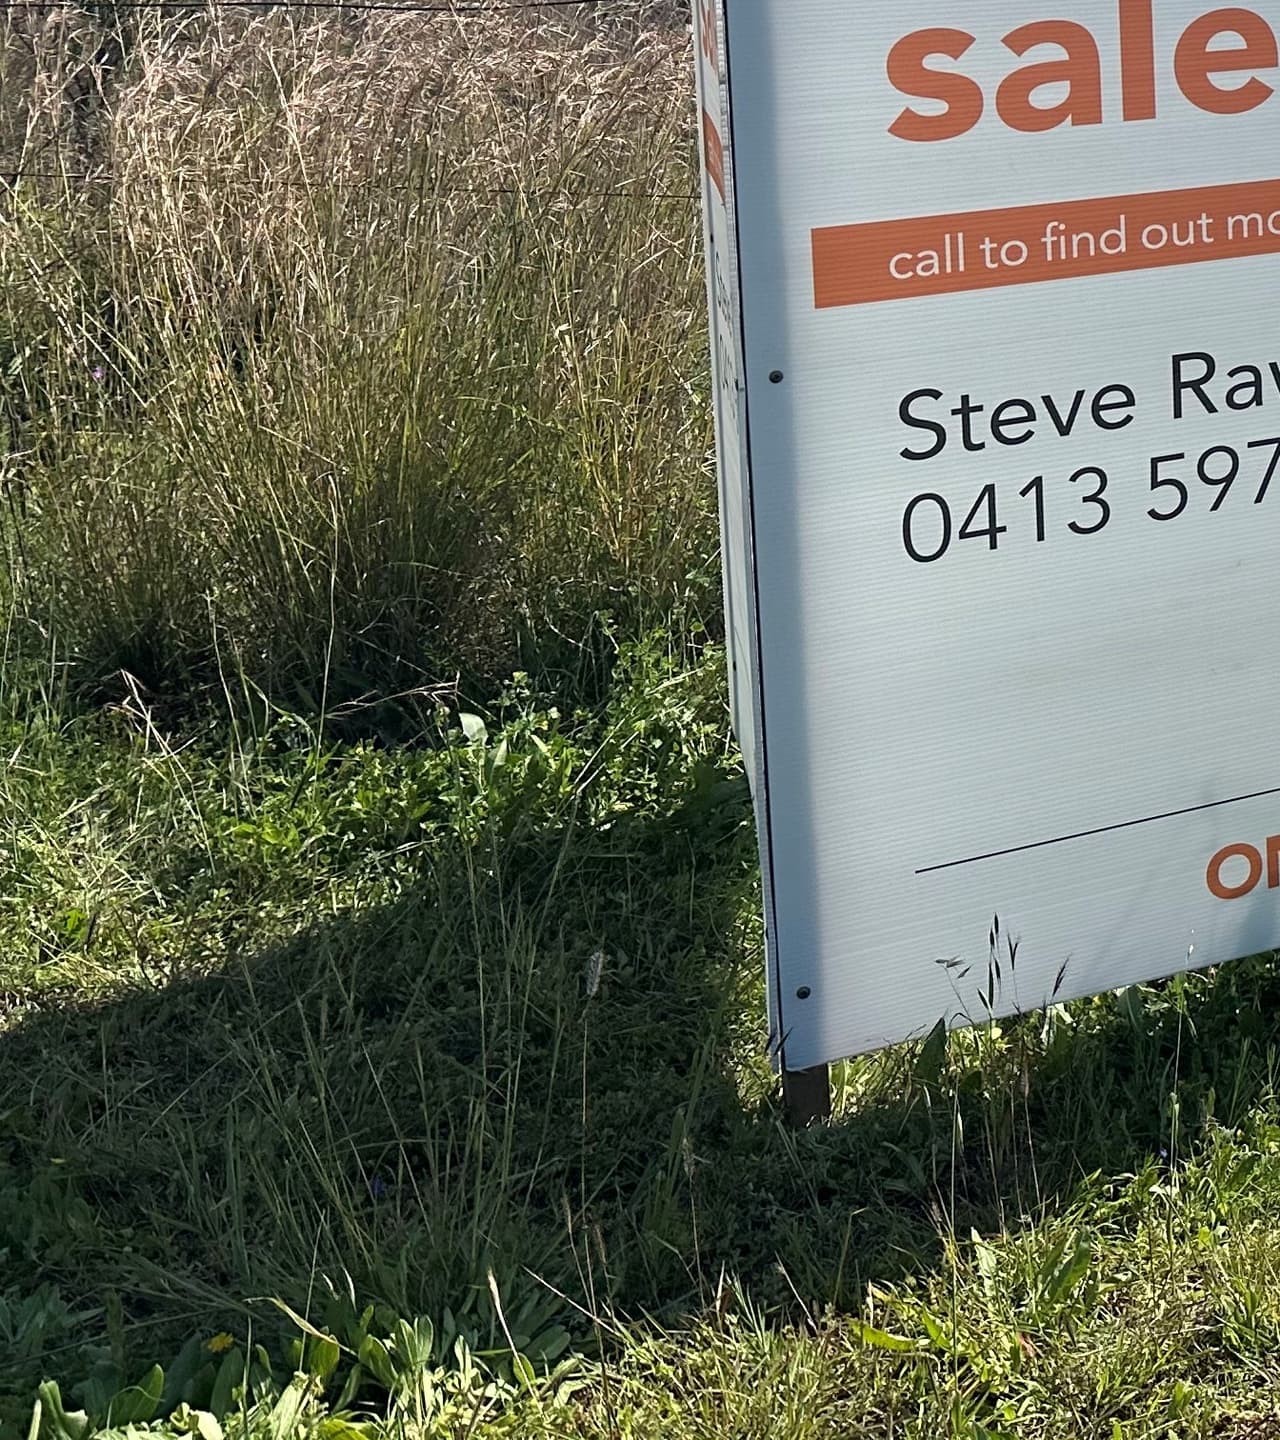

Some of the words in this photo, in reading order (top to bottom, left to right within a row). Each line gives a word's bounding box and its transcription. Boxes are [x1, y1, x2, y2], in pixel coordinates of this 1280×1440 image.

[889, 232, 965, 280] call
[979, 236, 1028, 269] to
[1041, 214, 1128, 261] find
[1141, 212, 1214, 250] out
[899, 385, 1136, 461] Steve
[901, 466, 1111, 563] 0413
